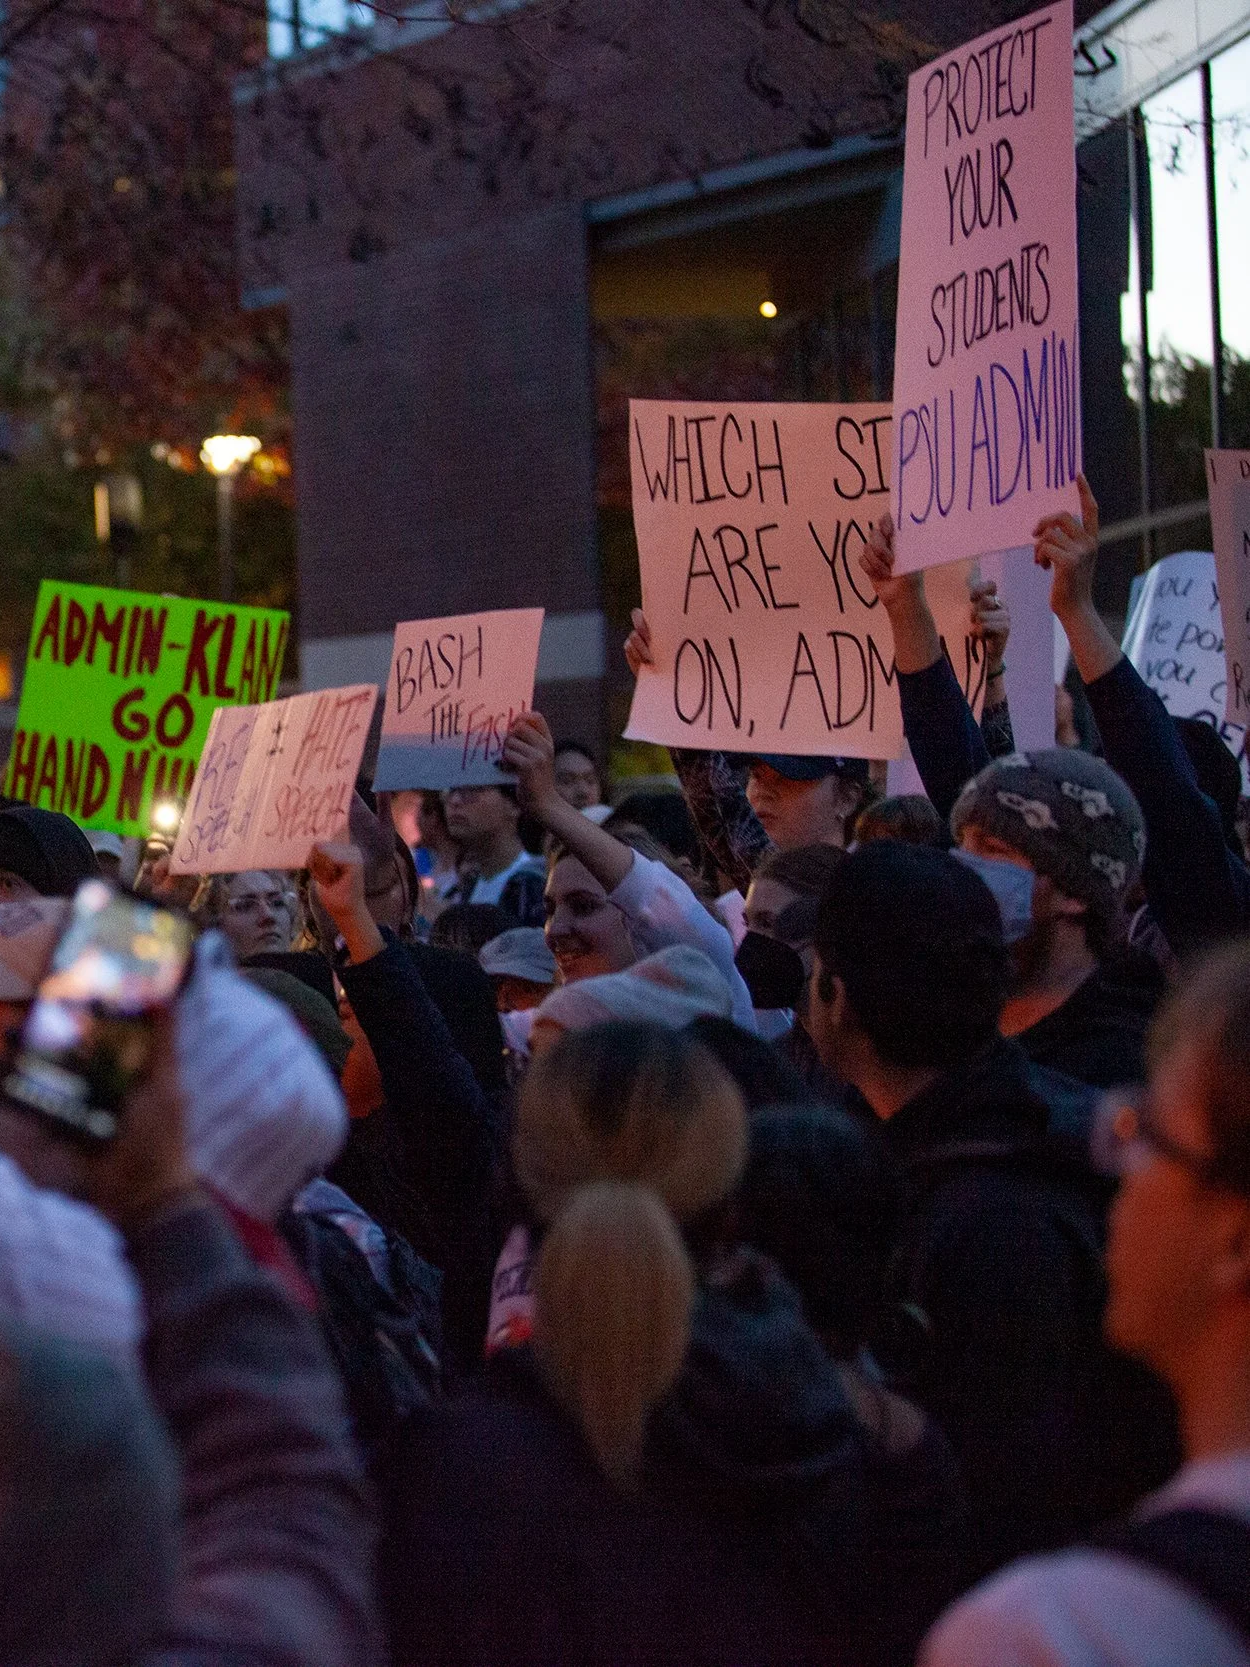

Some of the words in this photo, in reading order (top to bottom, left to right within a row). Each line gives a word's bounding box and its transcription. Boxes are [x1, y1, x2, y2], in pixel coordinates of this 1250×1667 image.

[923, 17, 1052, 158] PROTECT
[944, 137, 1018, 246] YOUR
[927, 241, 1050, 368] STUDENTS
[635, 413, 789, 504] WHICH
[897, 389, 956, 531] PSU
[967, 318, 1079, 511] ADMIN
[683, 524, 800, 615] ARE
[807, 519, 878, 614] YO
[111, 686, 196, 748] GO
[396, 625, 483, 716] BASH
[673, 636, 755, 737] ON,
[423, 696, 466, 744] THE
[6, 728, 111, 820] HAND
